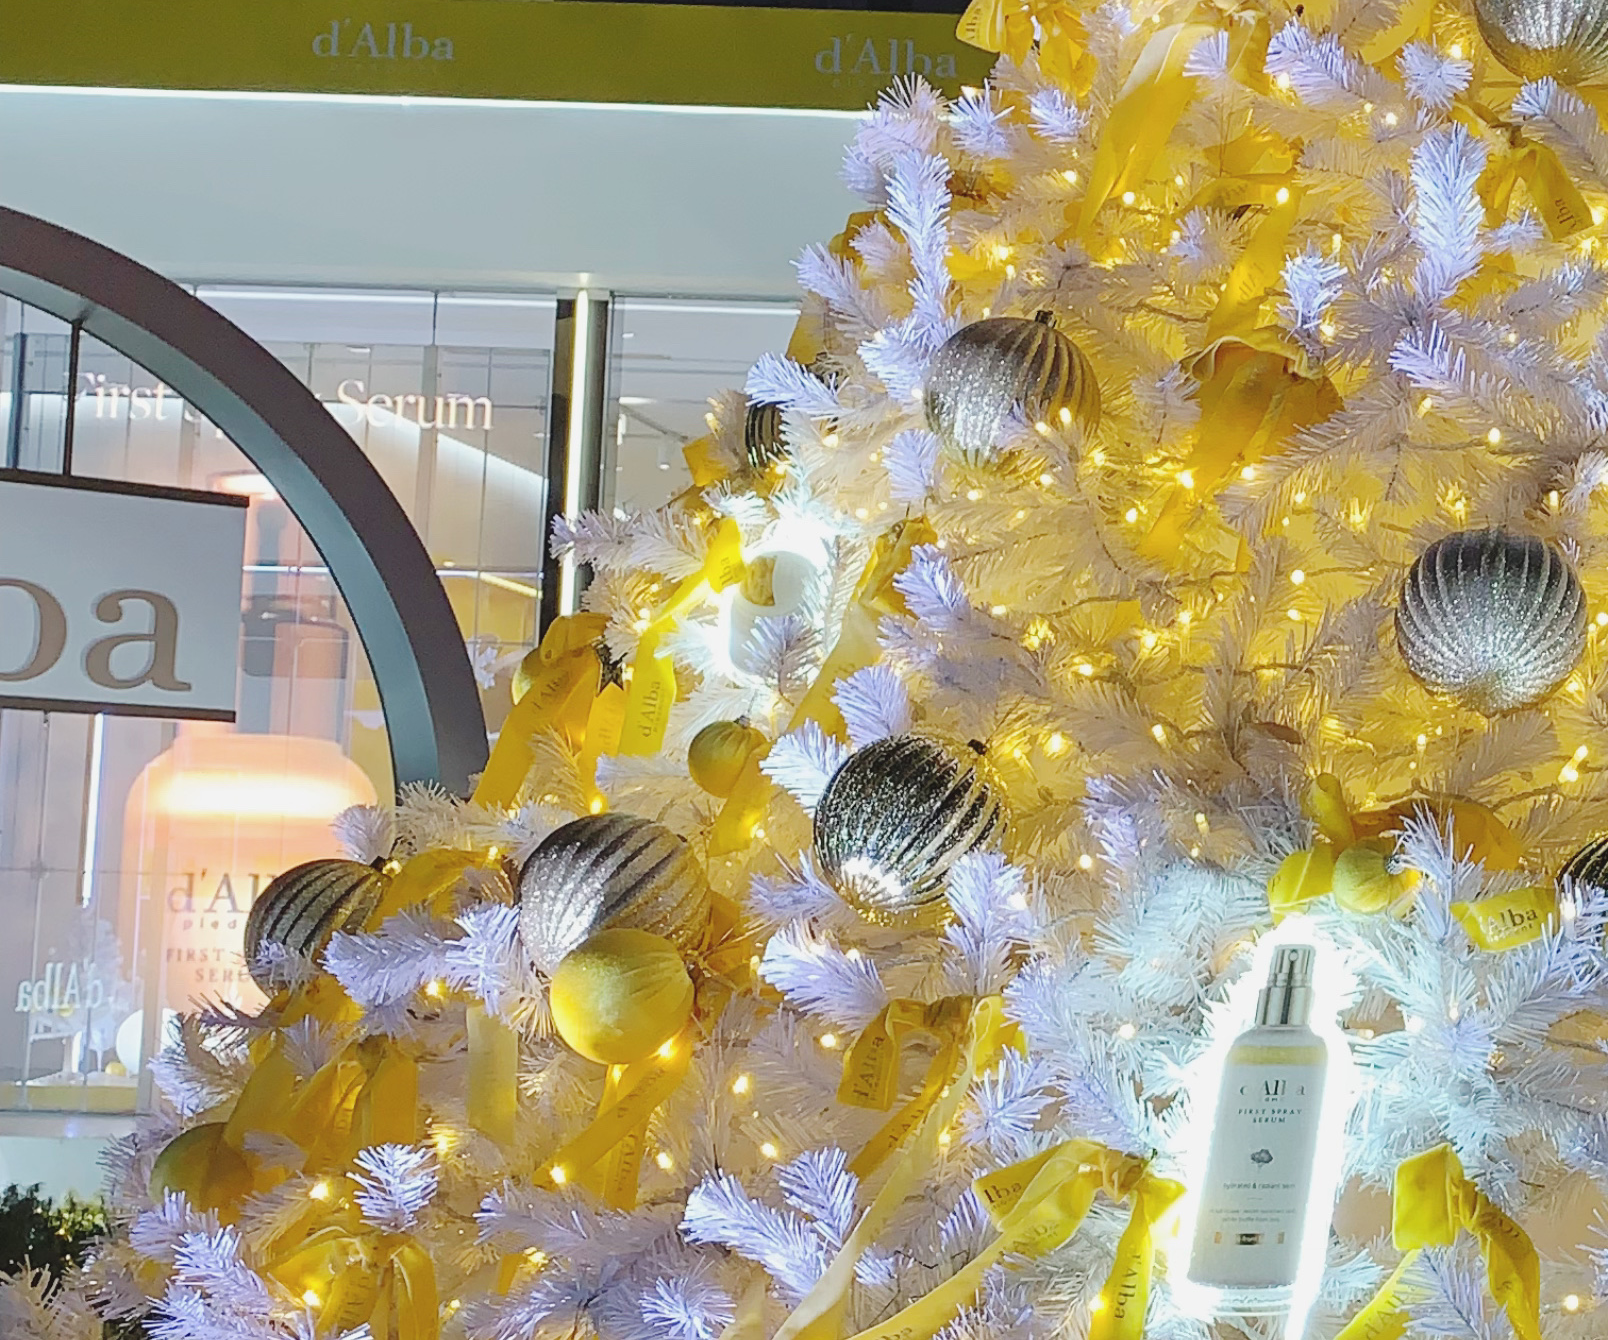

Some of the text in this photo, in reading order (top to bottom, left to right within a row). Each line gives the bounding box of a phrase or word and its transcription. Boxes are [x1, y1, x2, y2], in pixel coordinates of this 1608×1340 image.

[312, 18, 455, 61] d'Alba
[815, 34, 958, 78] d'Alba
[336, 378, 496, 431] Serum
[638, 680, 662, 738] d'Alba
[167, 868, 278, 913] d'Al
[167, 947, 225, 962] FIRST
